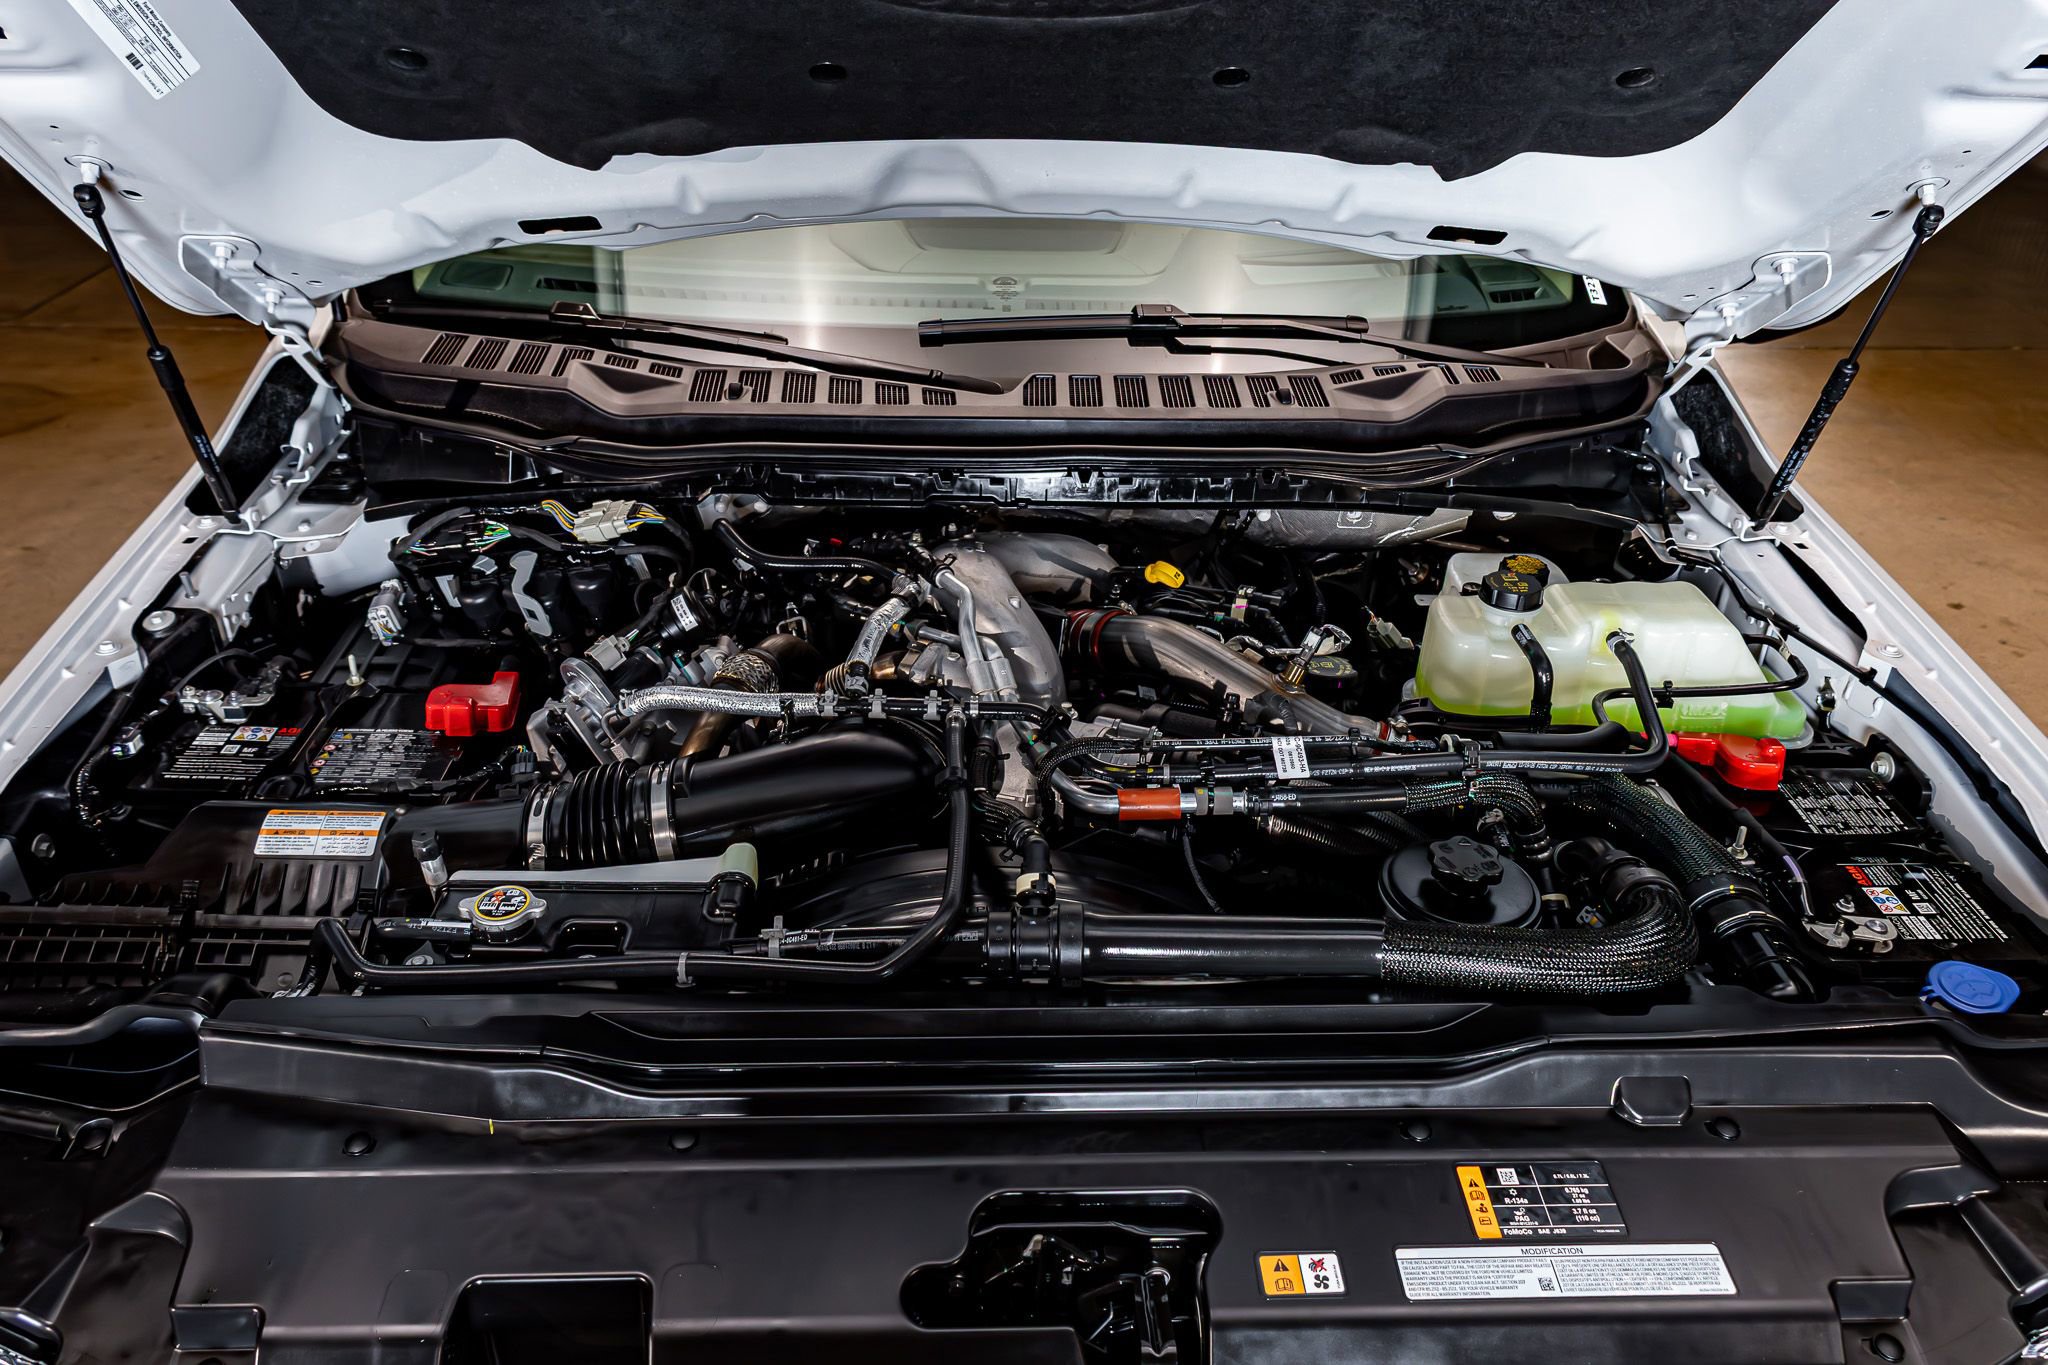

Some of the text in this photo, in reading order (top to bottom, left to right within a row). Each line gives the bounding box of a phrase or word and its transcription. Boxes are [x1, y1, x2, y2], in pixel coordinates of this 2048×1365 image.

[141, 1, 152, 11] Ford
[1844, 865, 1869, 886] AGM
[1520, 1247, 1584, 1255] MODIFICATION
